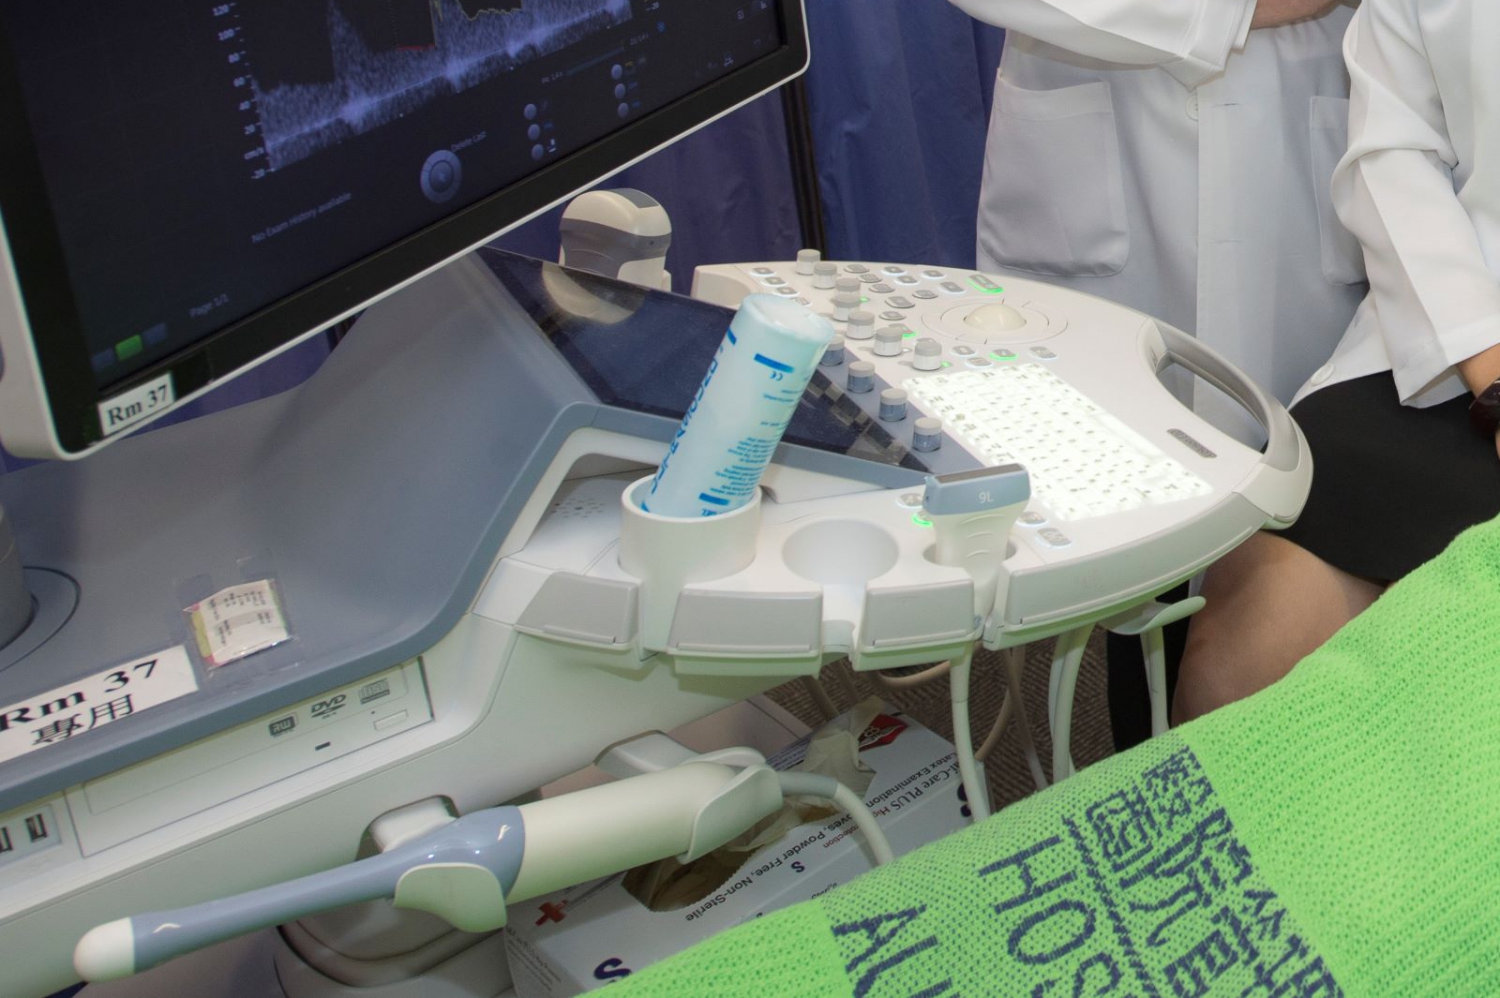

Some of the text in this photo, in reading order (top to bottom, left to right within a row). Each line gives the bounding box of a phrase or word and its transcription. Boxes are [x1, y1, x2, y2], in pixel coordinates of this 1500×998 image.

[108, 384, 167, 425] Rm 37
[978, 491, 993, 503] 9L
[0, 658, 159, 732] Rm 37
[311, 694, 347, 713] DVD
[31, 693, 134, 745] 專用
[865, 767, 931, 808] Examination
[891, 787, 924, 810] PLUS
[782, 831, 826, 860] Powder
[750, 858, 783, 877] Free,
[791, 861, 805, 873] S
[685, 876, 753, 922] Non-Sterile
[978, 835, 1121, 998] HOS
